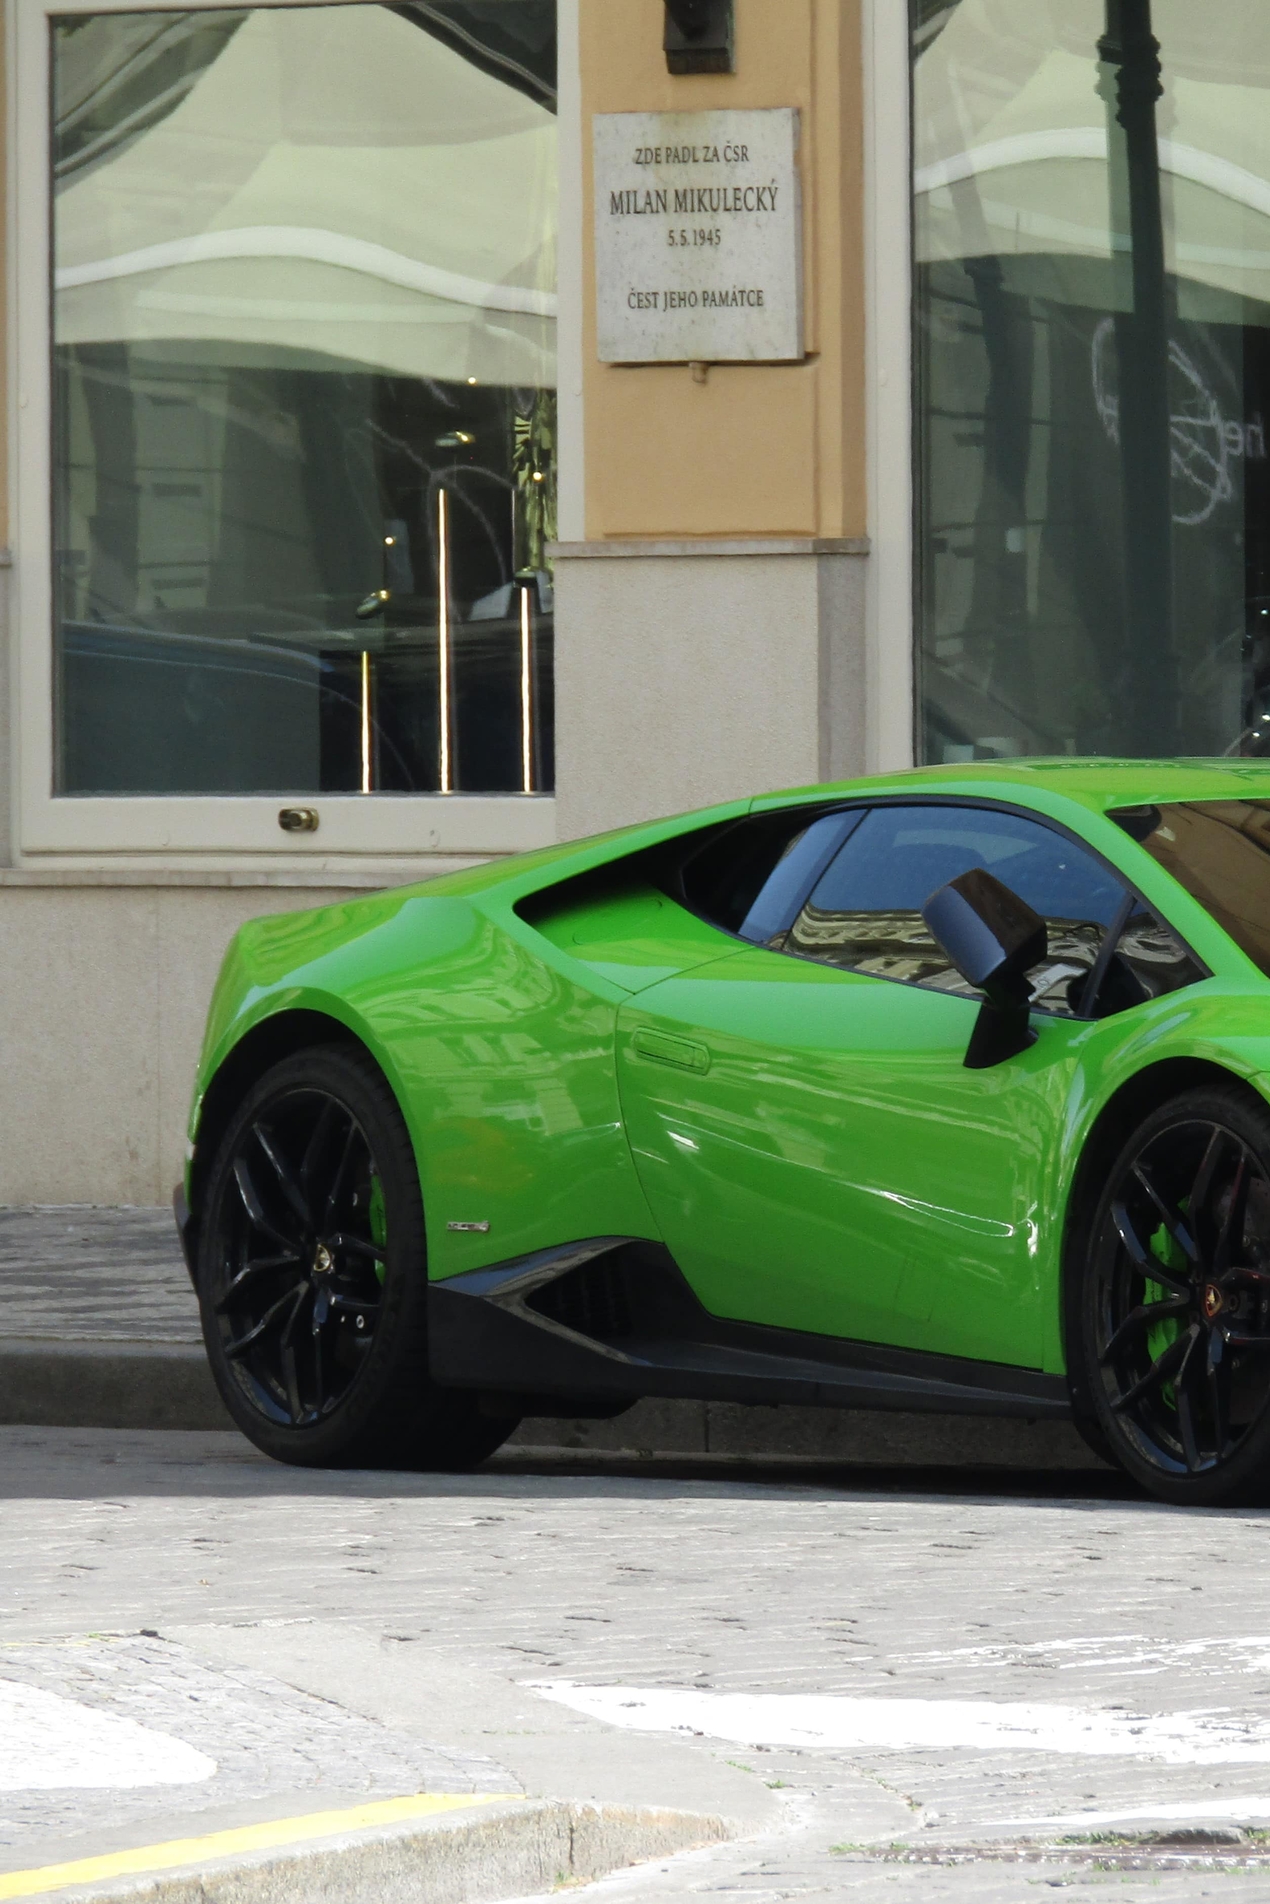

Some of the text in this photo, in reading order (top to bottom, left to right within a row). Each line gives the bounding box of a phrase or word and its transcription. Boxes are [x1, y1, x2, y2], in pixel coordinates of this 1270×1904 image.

[635, 140, 750, 165] ZDE PADL ZA ČSR
[610, 178, 779, 216] MILAN MIKULECKÝ
[627, 284, 764, 312] ČEST JEHO PAMÁTCE
